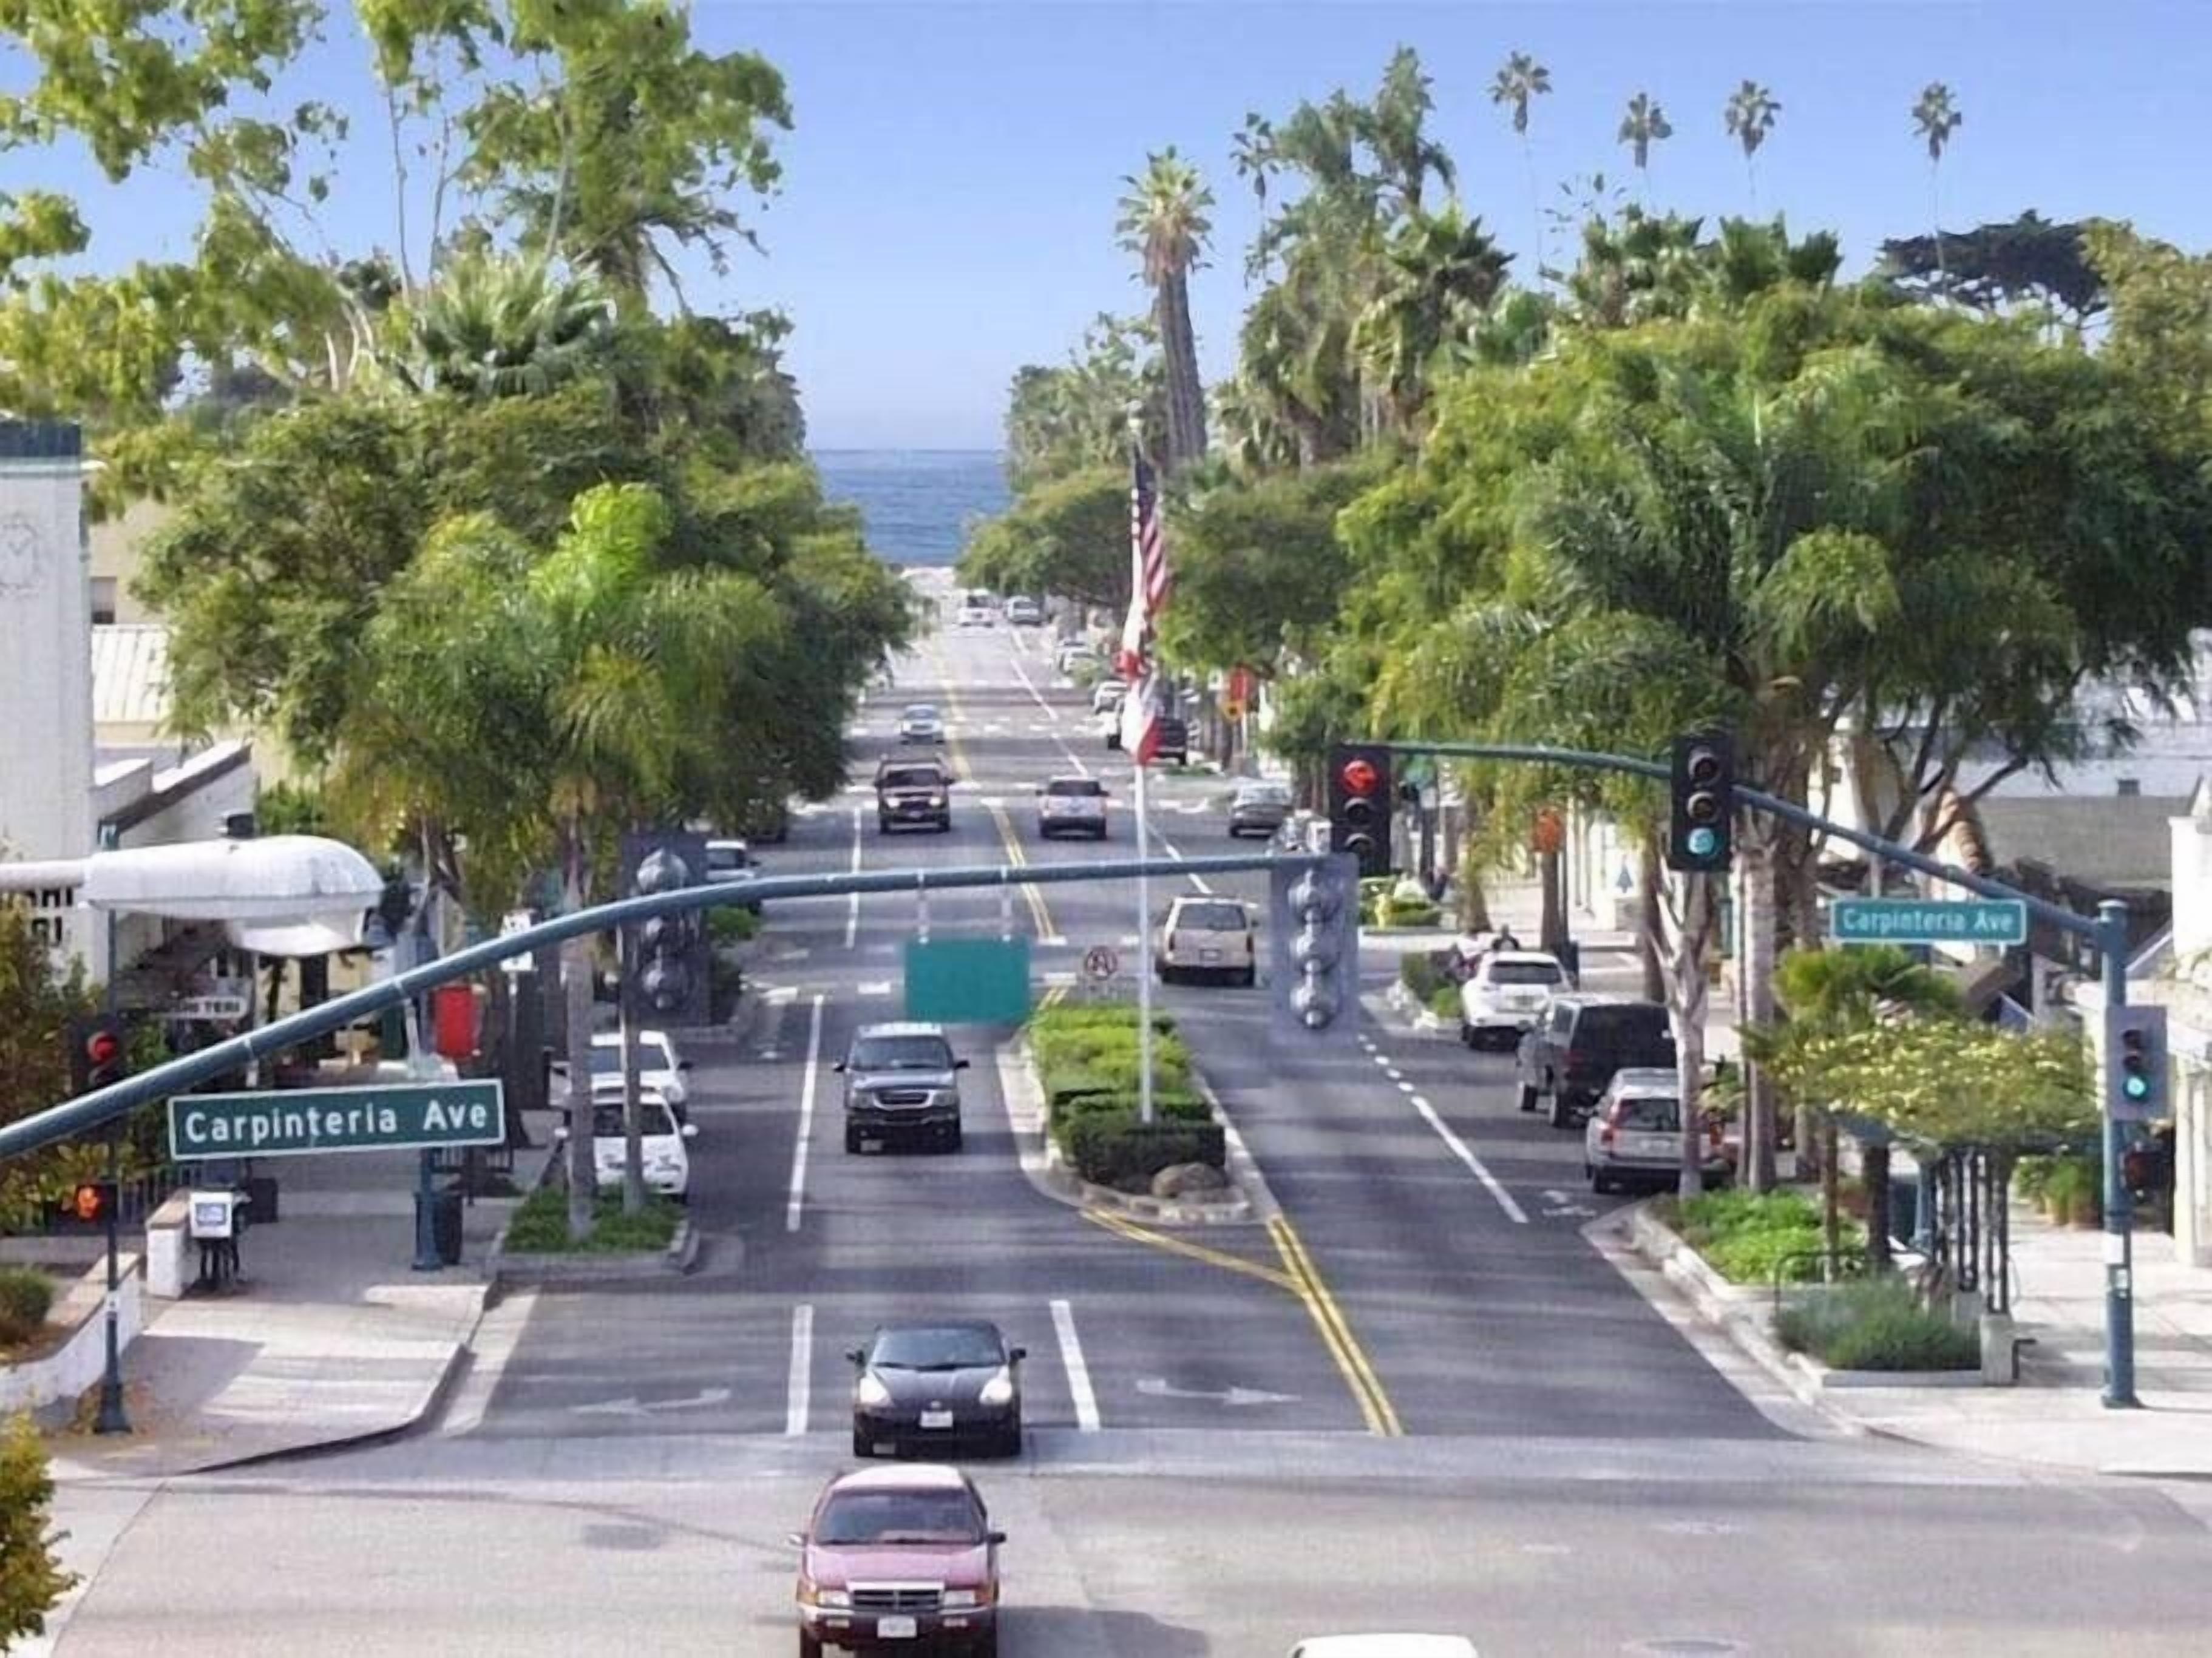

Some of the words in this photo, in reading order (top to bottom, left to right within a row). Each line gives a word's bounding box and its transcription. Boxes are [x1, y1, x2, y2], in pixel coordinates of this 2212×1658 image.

[1842, 908, 1966, 935] Carpinteria
[1973, 910, 2014, 932] Ave
[185, 1102, 397, 1146] Carpinteria
[422, 1100, 487, 1131] Ave
